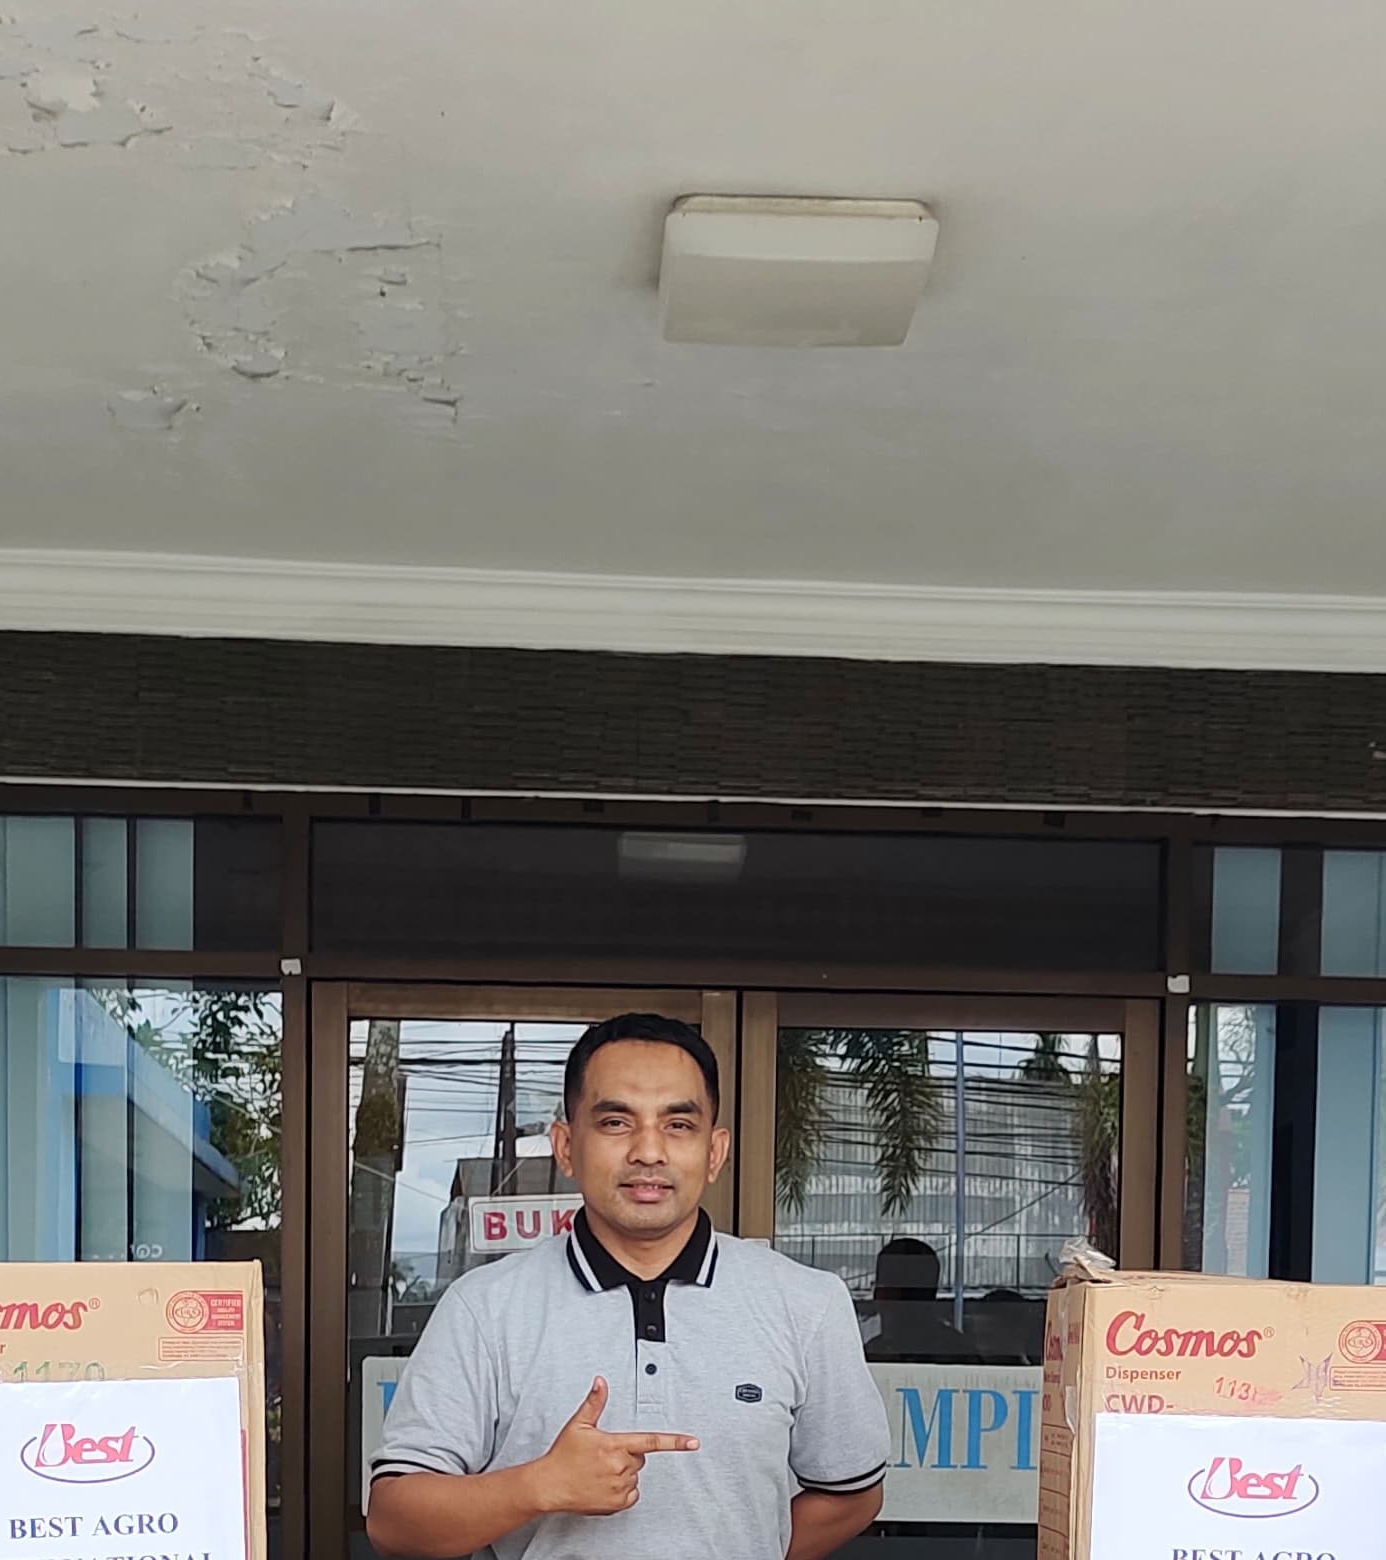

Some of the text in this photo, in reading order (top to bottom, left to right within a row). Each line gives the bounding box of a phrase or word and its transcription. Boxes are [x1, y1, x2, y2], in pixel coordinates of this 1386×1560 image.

[483, 1208, 576, 1241] BUK
[1106, 1310, 1262, 1358] Cosmos
[1106, 1366, 1182, 1382] Dispenser
[34, 1423, 139, 1467] Best
[885, 1388, 1040, 1469] MPI
[1200, 1457, 1304, 1500] Best
[9, 1513, 178, 1539] BEST AGRO
